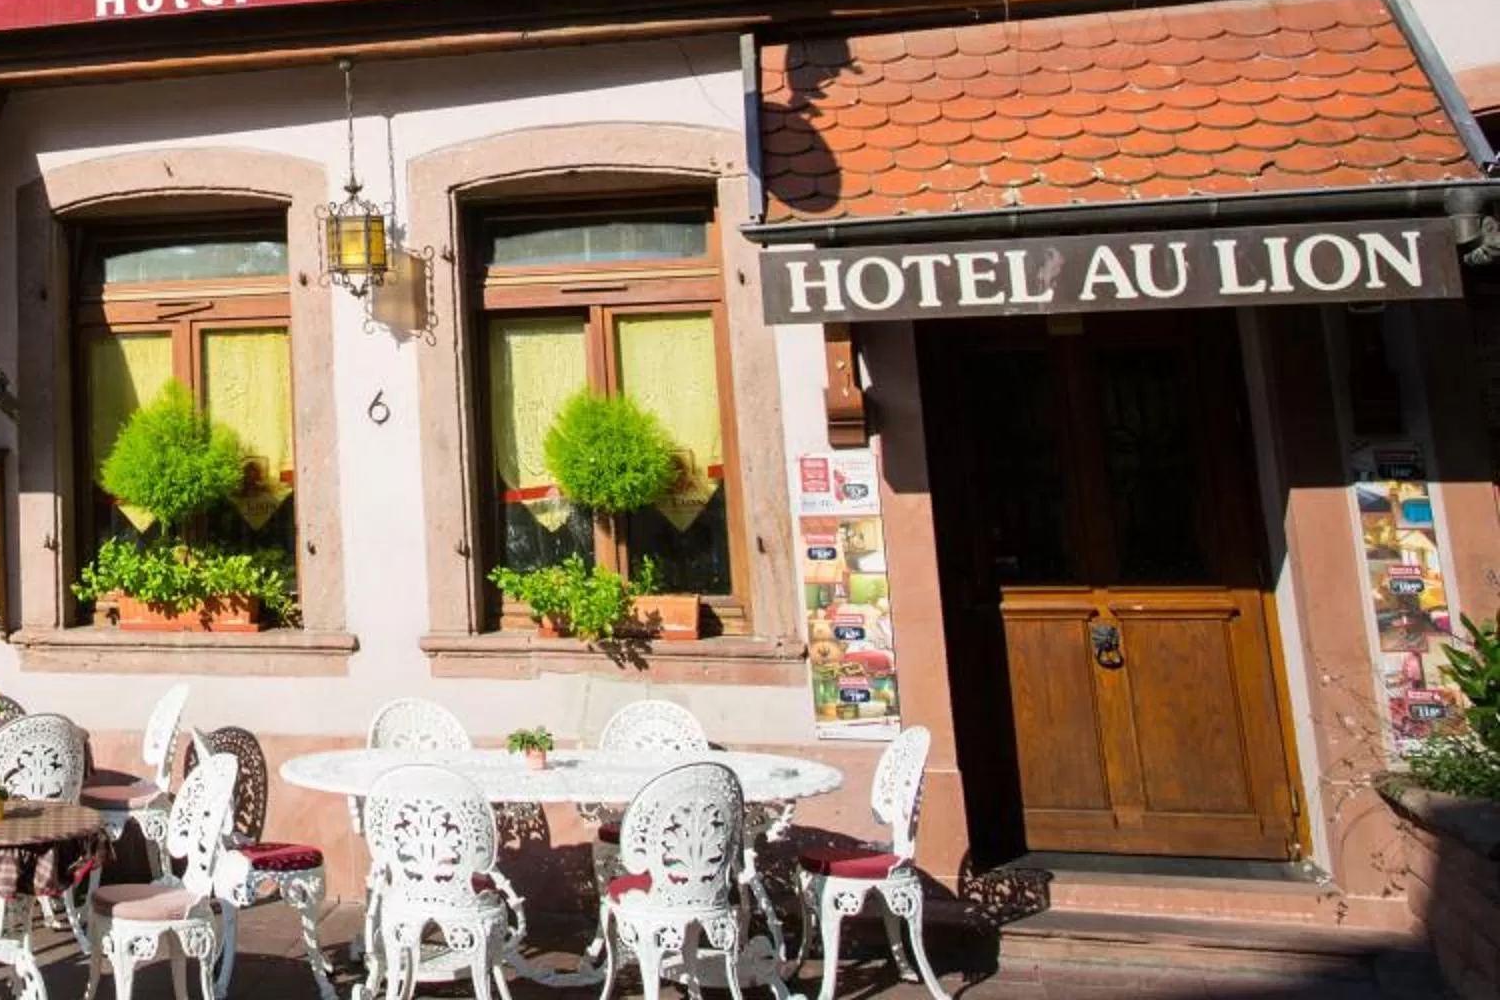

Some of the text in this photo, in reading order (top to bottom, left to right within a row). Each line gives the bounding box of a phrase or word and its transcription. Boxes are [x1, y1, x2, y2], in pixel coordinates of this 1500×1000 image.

[784, 231, 1423, 313] HOTEL AU LION
[367, 389, 391, 427] 6
